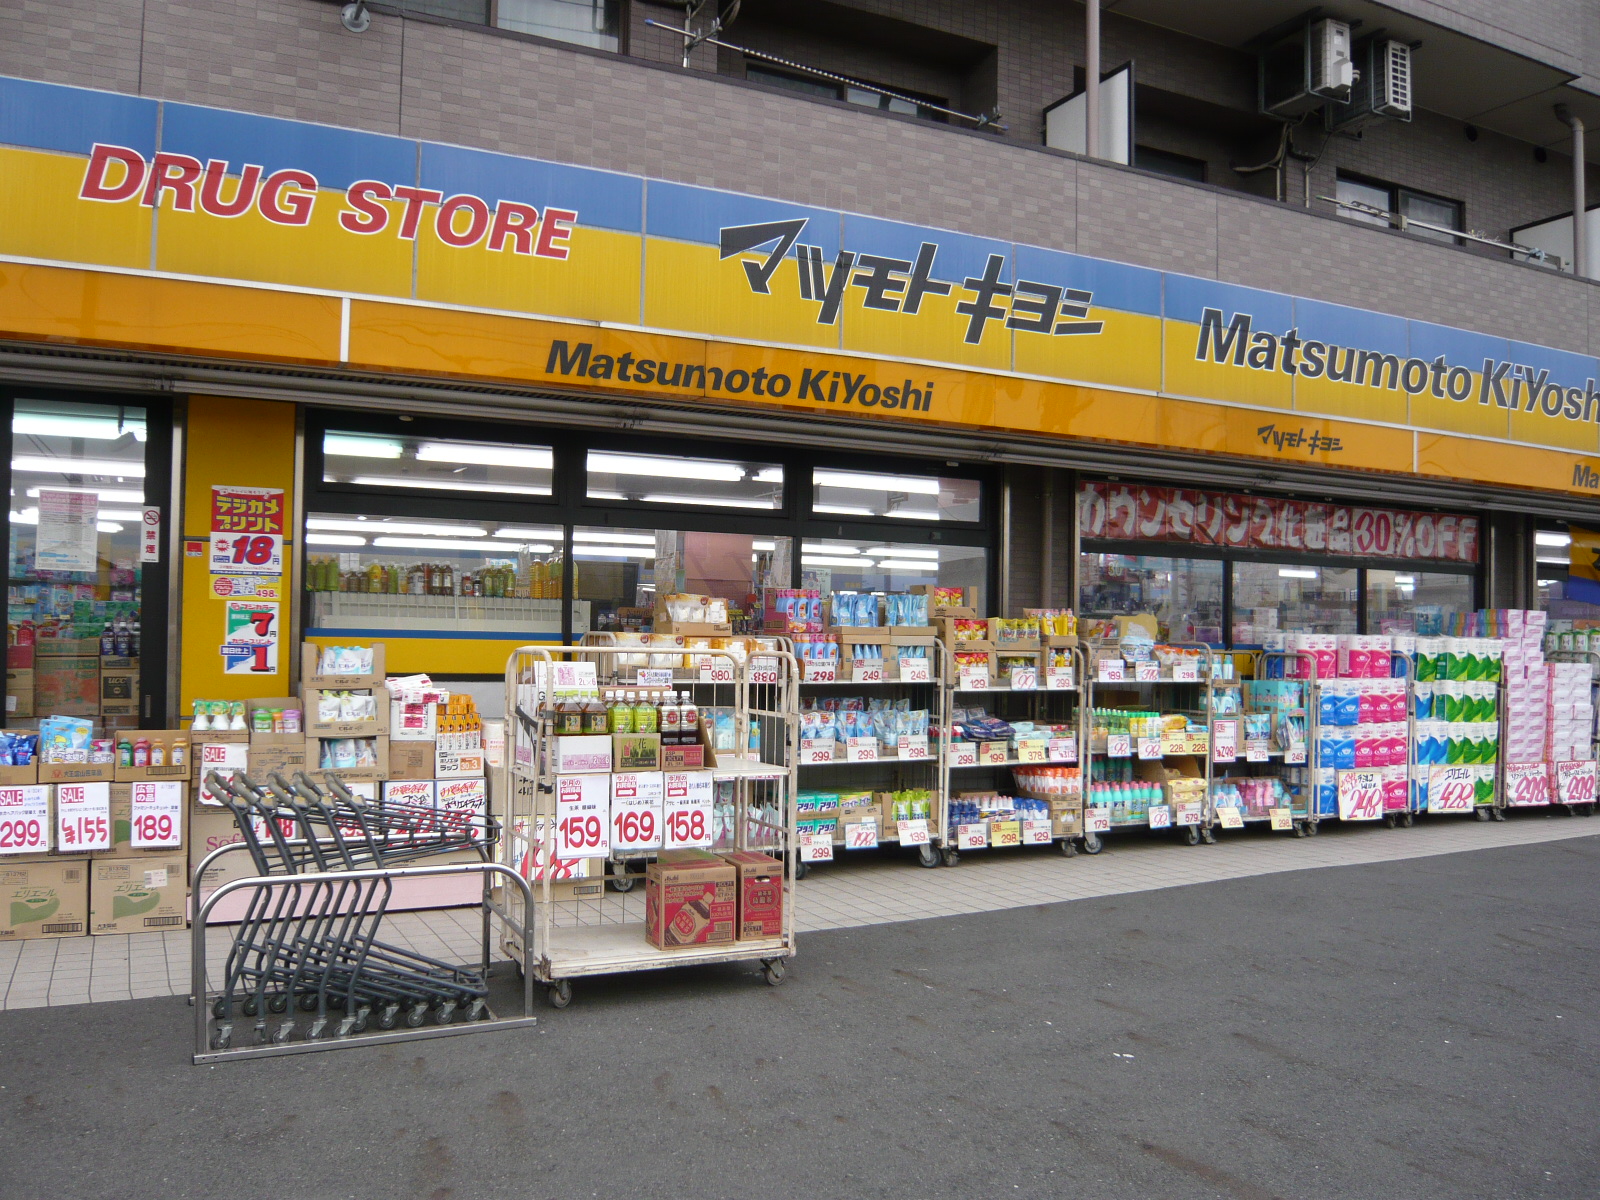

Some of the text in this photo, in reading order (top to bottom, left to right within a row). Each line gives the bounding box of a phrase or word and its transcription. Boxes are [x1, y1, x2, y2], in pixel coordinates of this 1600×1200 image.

[79, 142, 579, 260] DRUG STORE
[719, 217, 1105, 345] マツモトキヨシ
[1195, 306, 1473, 402] Matsumoto
[544, 339, 935, 413] Matsumoto KiYoshi
[1256, 423, 1343, 455] マツモトキヨシ
[216, 495, 279, 515] デジカメ
[216, 515, 279, 532] プリント
[232, 535, 275, 565] 18
[250, 612, 275, 637] 7
[250, 646, 270, 672] 1
[862, 670, 879, 681] 249
[204, 747, 225, 762] SALE
[812, 751, 830, 762] 299
[0, 790, 23, 806] SALE
[61, 787, 84, 804] SALE
[1515, 775, 1548, 803] 298
[812, 847, 830, 859] 299
